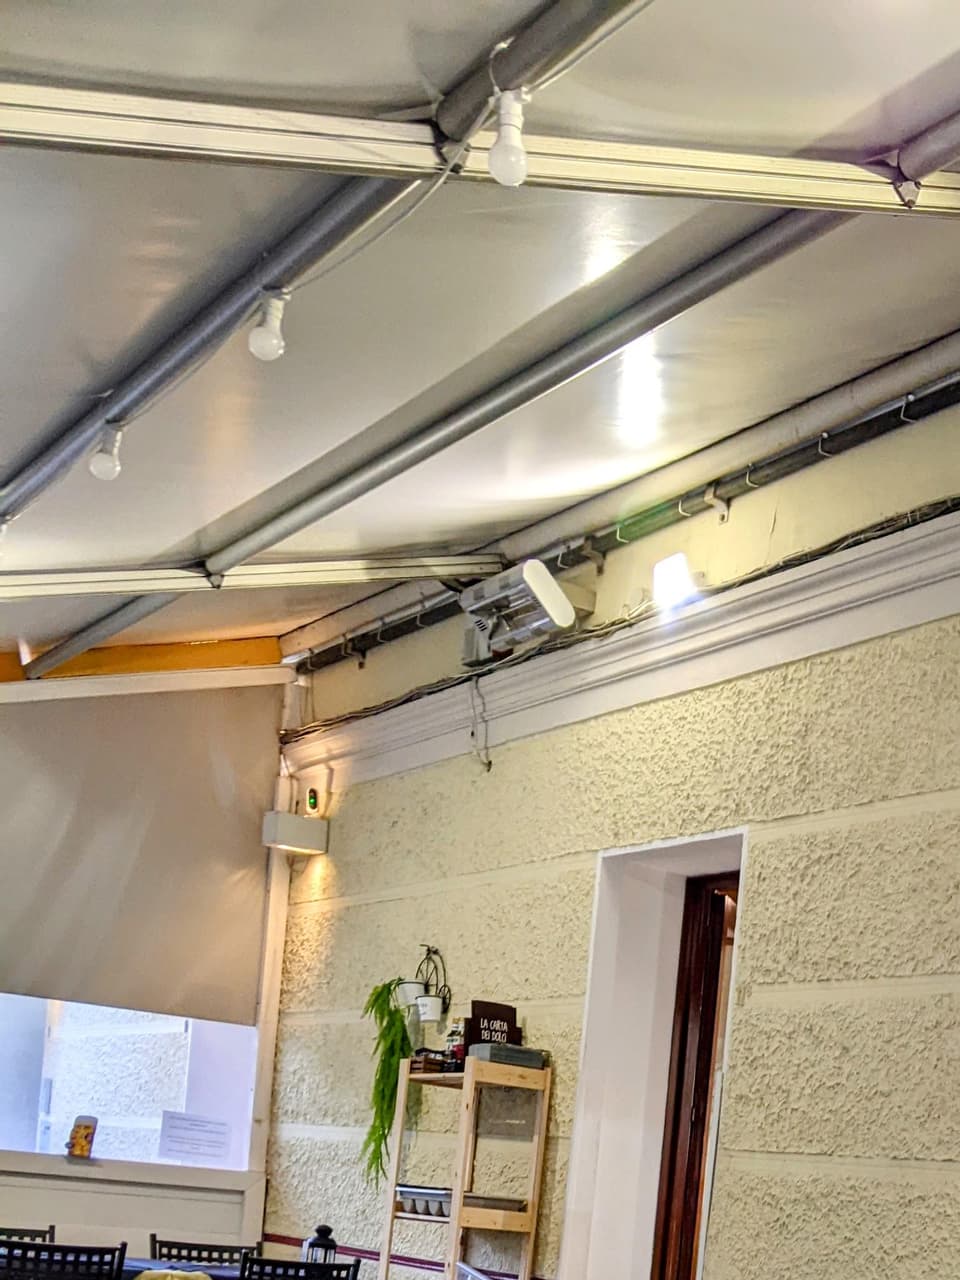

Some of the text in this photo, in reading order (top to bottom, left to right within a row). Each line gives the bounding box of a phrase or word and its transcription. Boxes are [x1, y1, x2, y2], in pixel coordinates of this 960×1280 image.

[480, 1017, 508, 1032] LA CARTA
[481, 1029, 490, 1040] DEI
